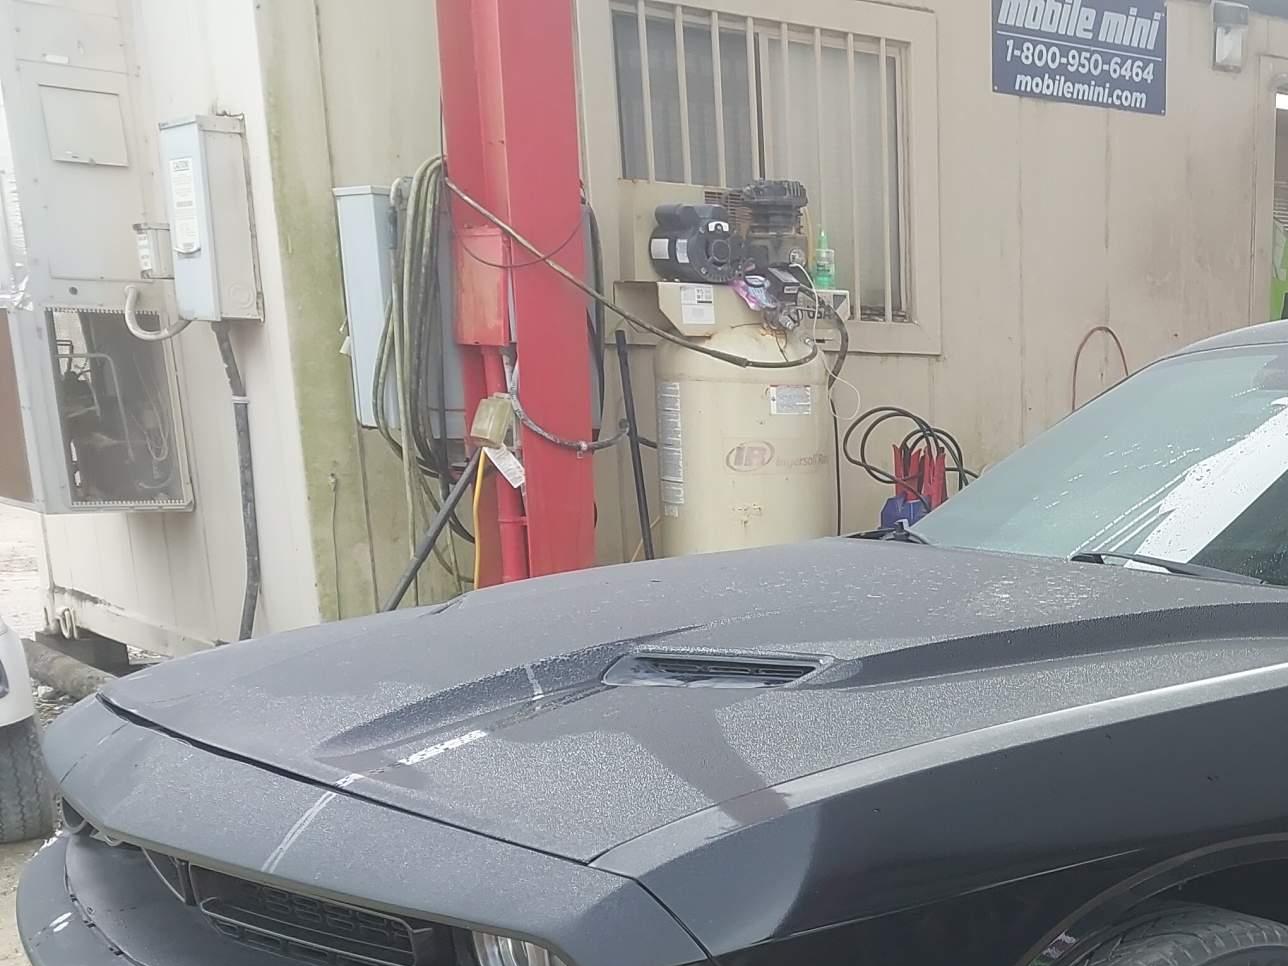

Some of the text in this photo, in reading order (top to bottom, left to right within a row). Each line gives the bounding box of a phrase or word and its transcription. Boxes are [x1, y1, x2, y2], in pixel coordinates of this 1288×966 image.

[998, 0, 1161, 50] mobile mini
[1006, 39, 1154, 84] 1-800-950-6464
[1015, 73, 1146, 109] mobilemini.com
